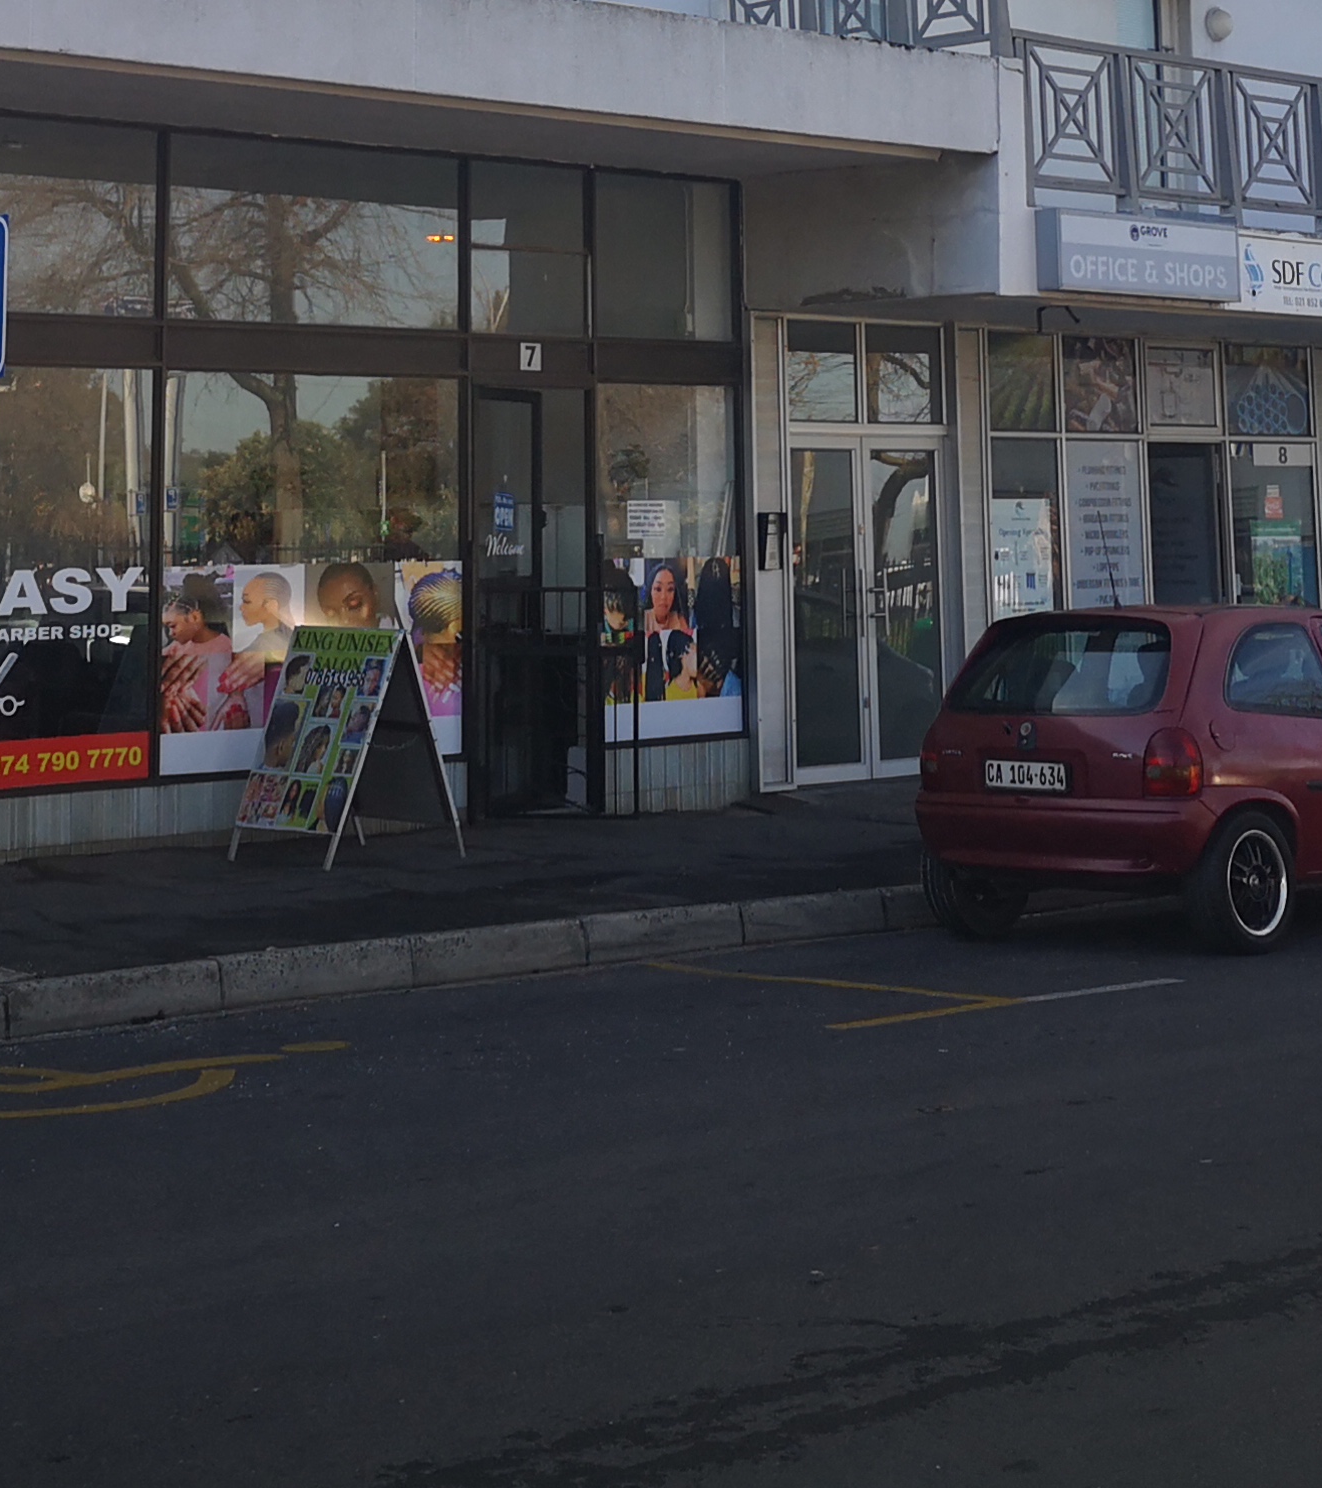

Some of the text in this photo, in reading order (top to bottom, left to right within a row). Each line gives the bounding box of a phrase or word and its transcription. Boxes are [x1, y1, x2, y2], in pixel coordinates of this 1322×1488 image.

[1140, 225, 1168, 239] GROVE
[1070, 254, 1227, 289] OFFICE & SHOPS
[1271, 259, 1305, 286] SDF
[1295, 296, 1305, 307] 021
[525, 345, 537, 367] 7
[1278, 446, 1288, 464] 8
[69, 623, 123, 639] SHOP
[293, 631, 396, 653] KING UNISEX
[313, 655, 365, 670] SALON
[37, 750, 80, 772] 790
[87, 745, 143, 768] 7770
[987, 763, 1004, 784] CA
